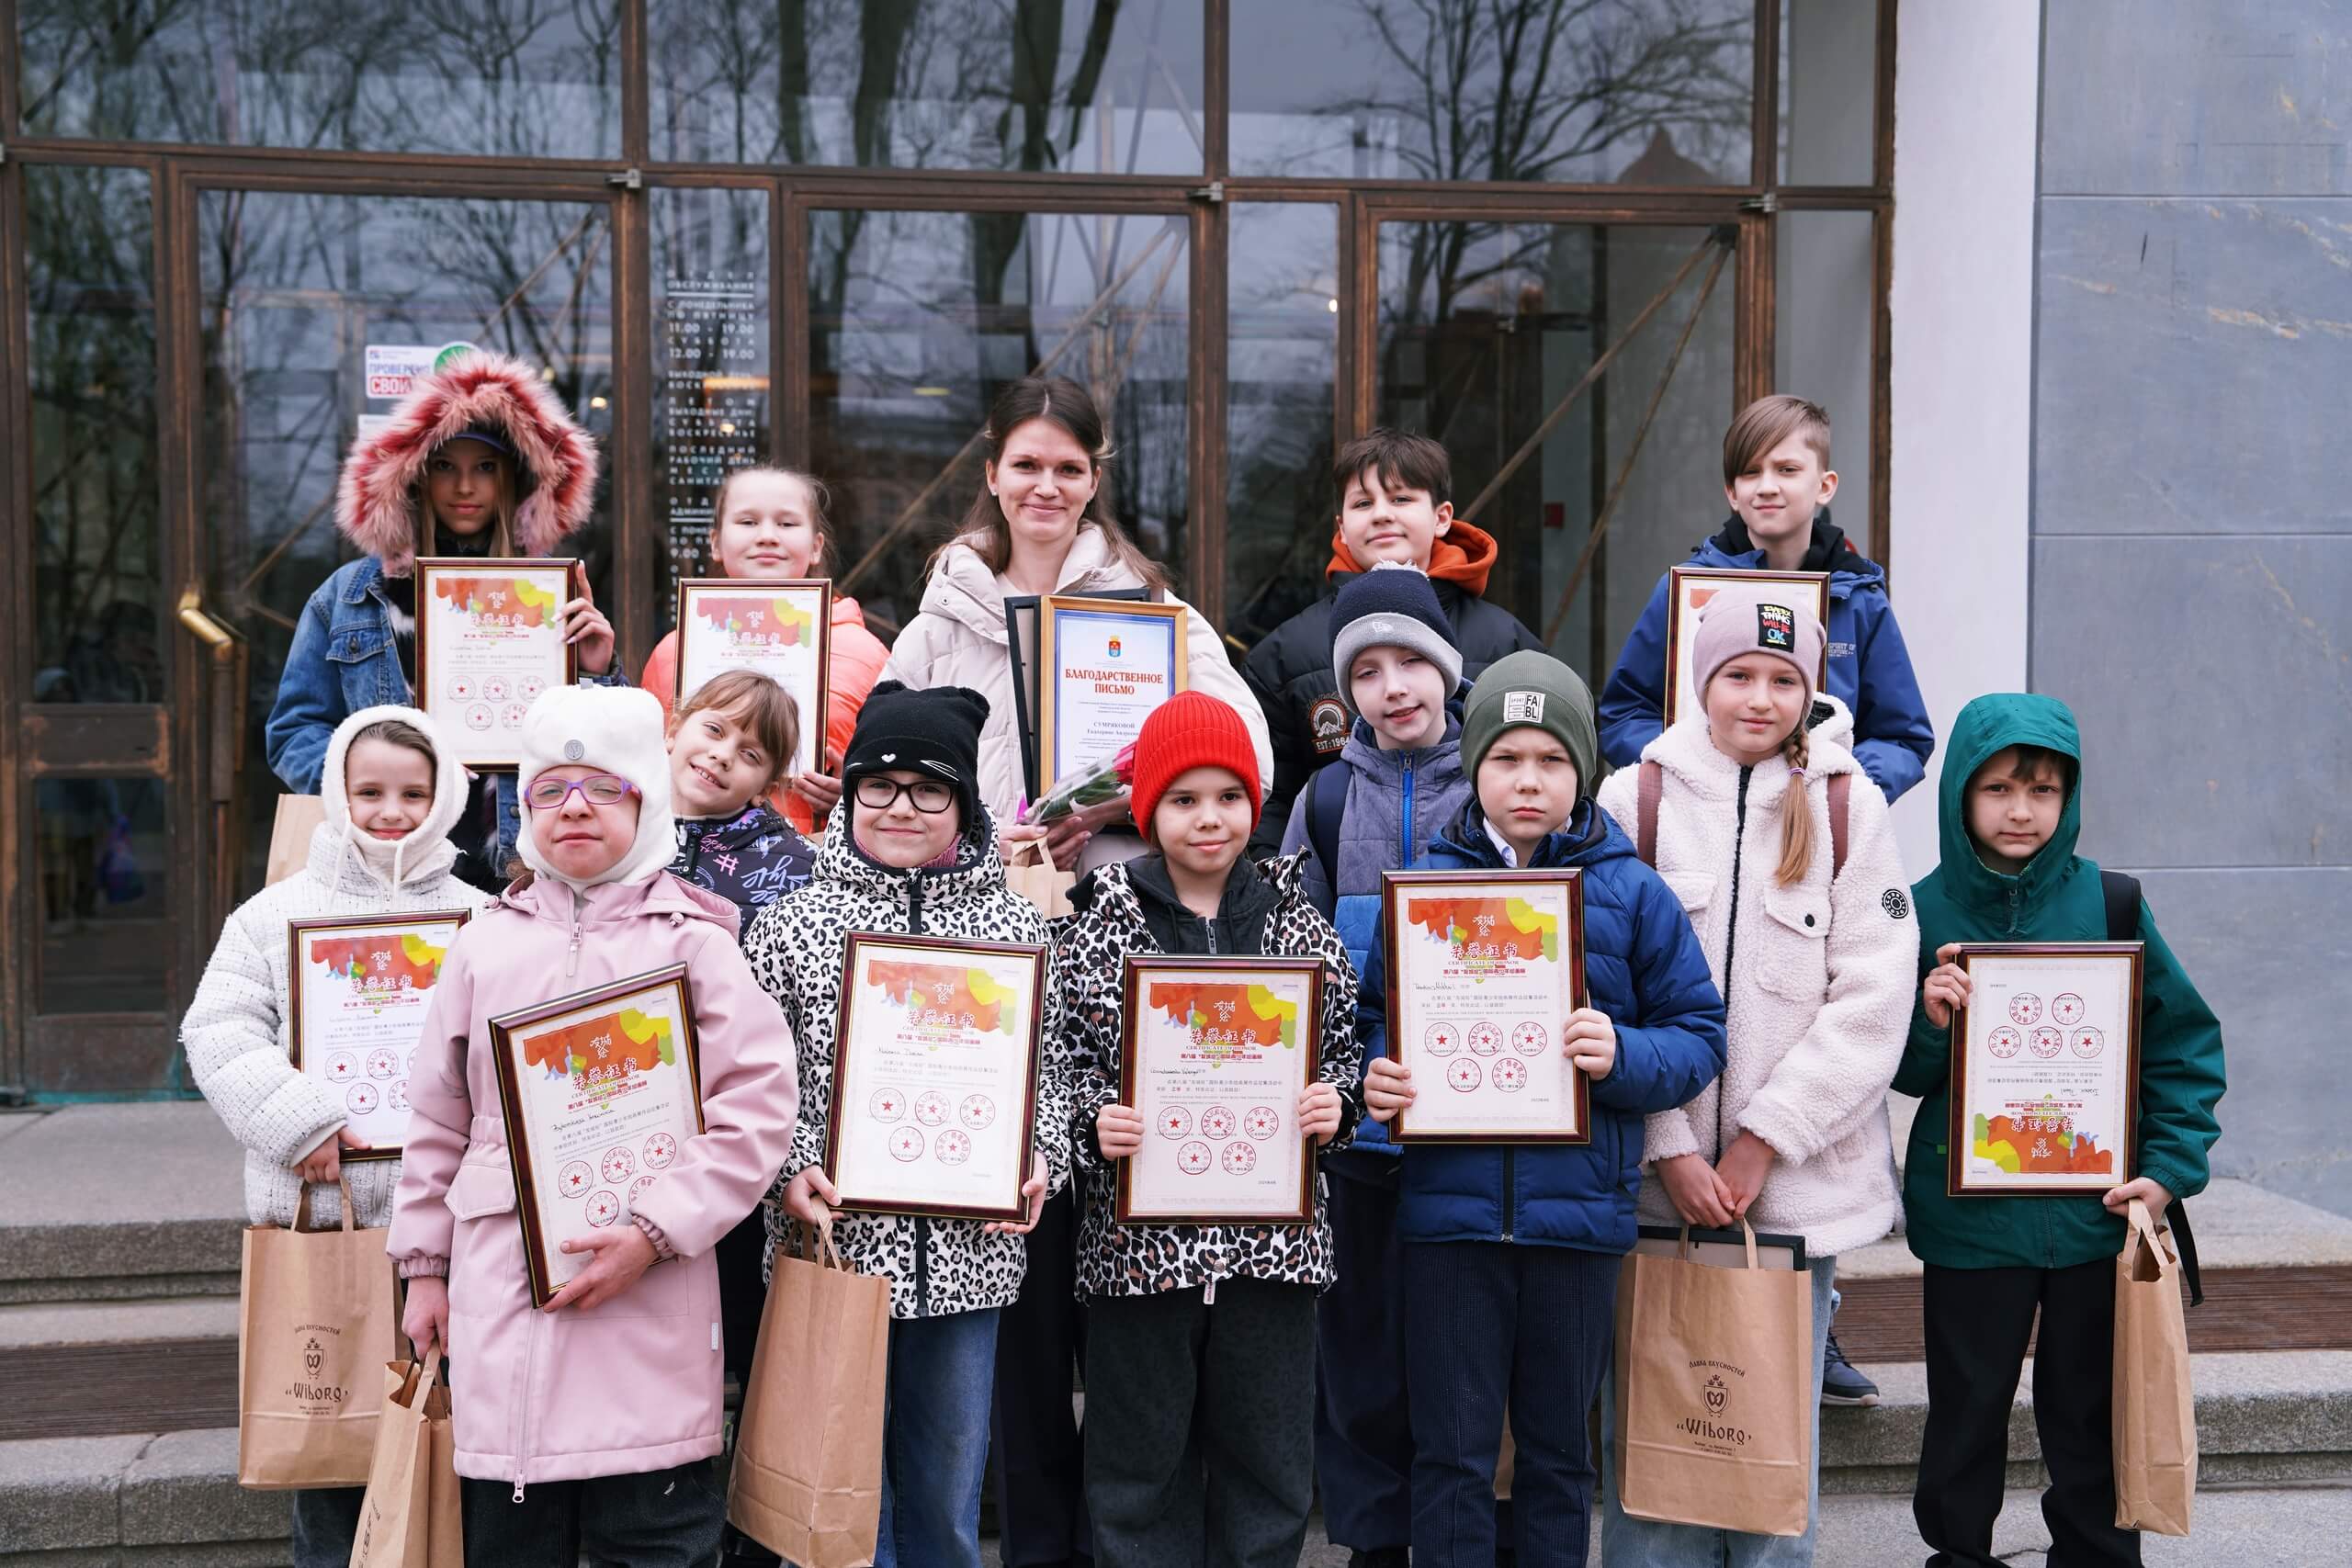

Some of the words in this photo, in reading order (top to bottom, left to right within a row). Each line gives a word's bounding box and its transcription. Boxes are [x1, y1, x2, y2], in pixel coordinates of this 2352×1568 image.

[1760, 611, 1792, 626] THING
[1767, 628, 1786, 643] OK
[1065, 669, 1163, 684] БЛАГОДАРСТВЕННОЕ
[1094, 683, 1135, 695] ПИСЬМО
[1525, 694, 1538, 706] FA
[1525, 705, 1537, 718] BL
[1452, 942, 1518, 960] 荣誉证书
[1190, 1028, 1256, 1045] 荣誉证书
[573, 1057, 637, 1090] 荣誉证书
